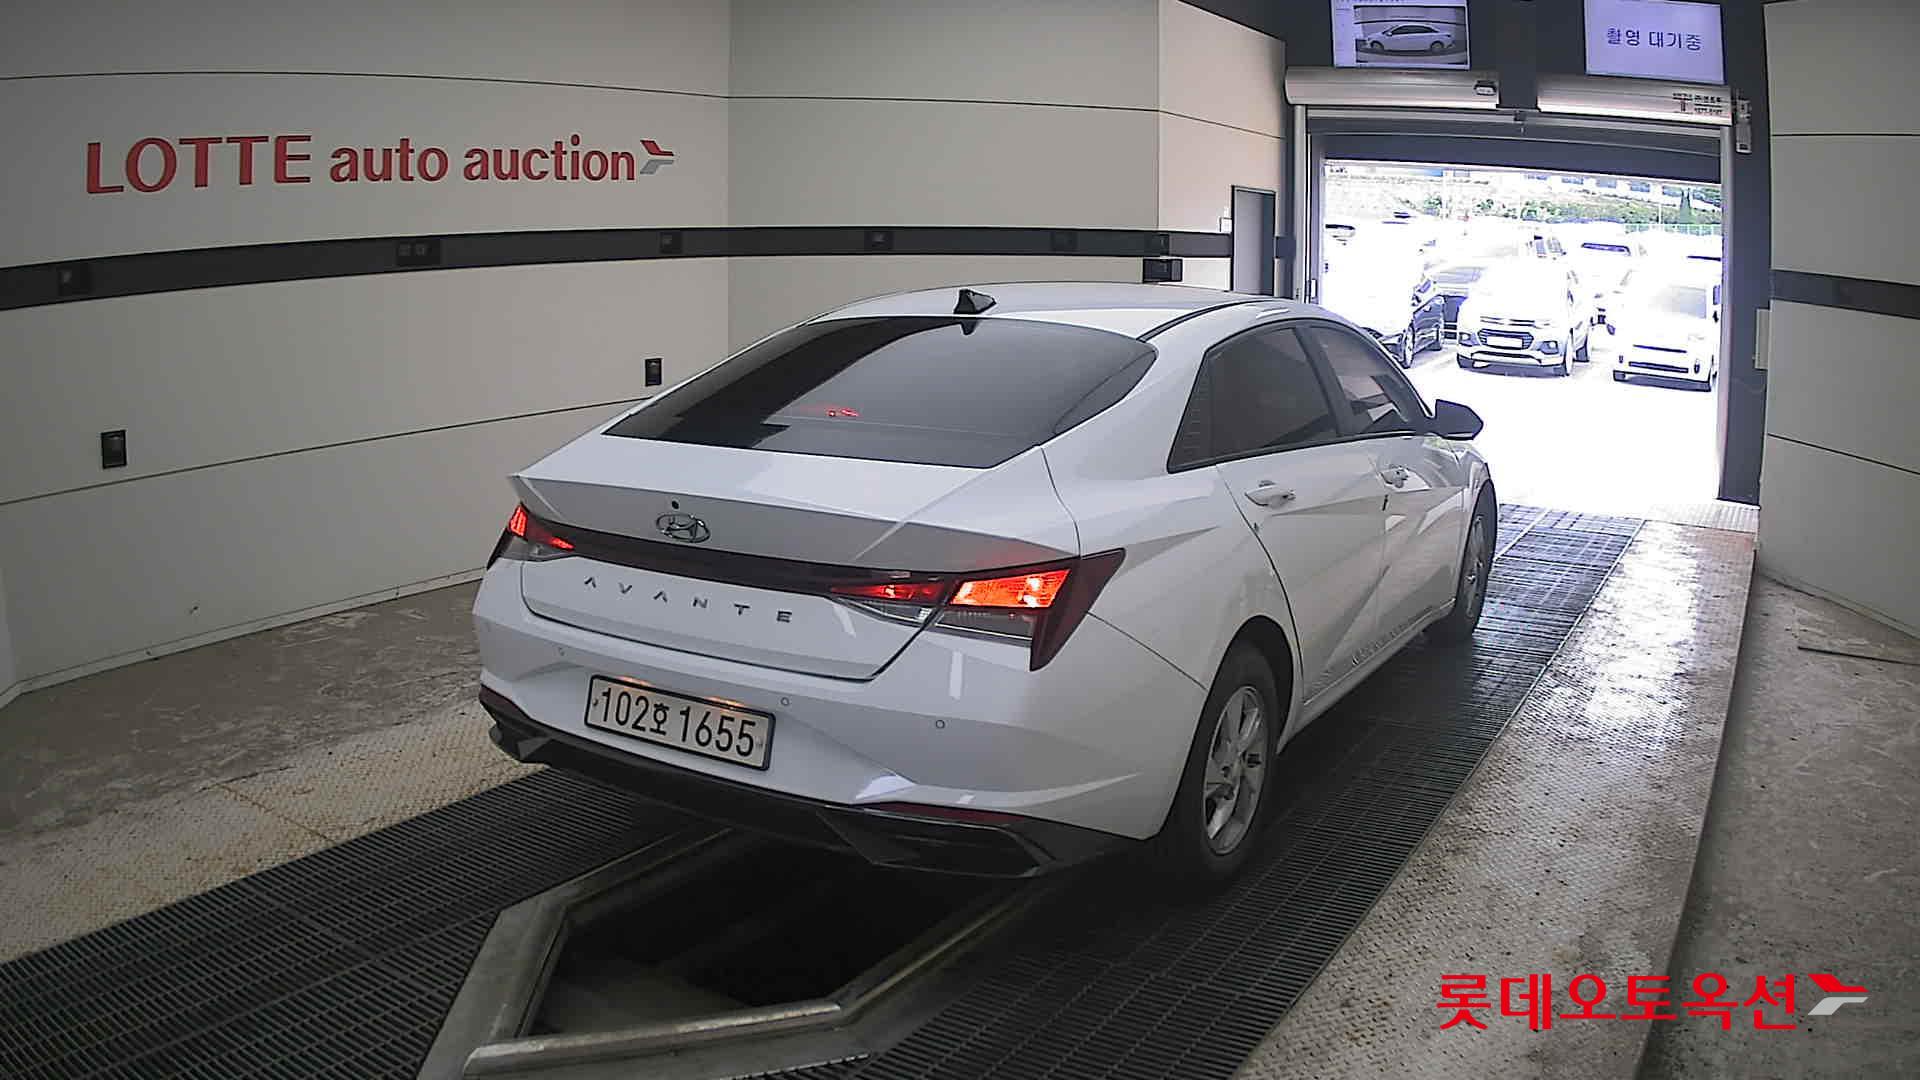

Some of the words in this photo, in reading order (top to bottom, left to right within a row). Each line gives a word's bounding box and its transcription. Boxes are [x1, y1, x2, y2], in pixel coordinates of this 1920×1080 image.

[1648, 31, 1702, 51] 대기중
[86, 135, 312, 194] LOTTE
[329, 137, 449, 183] auto
[463, 133, 636, 182] auction
[584, 576, 793, 624] AVANTE
